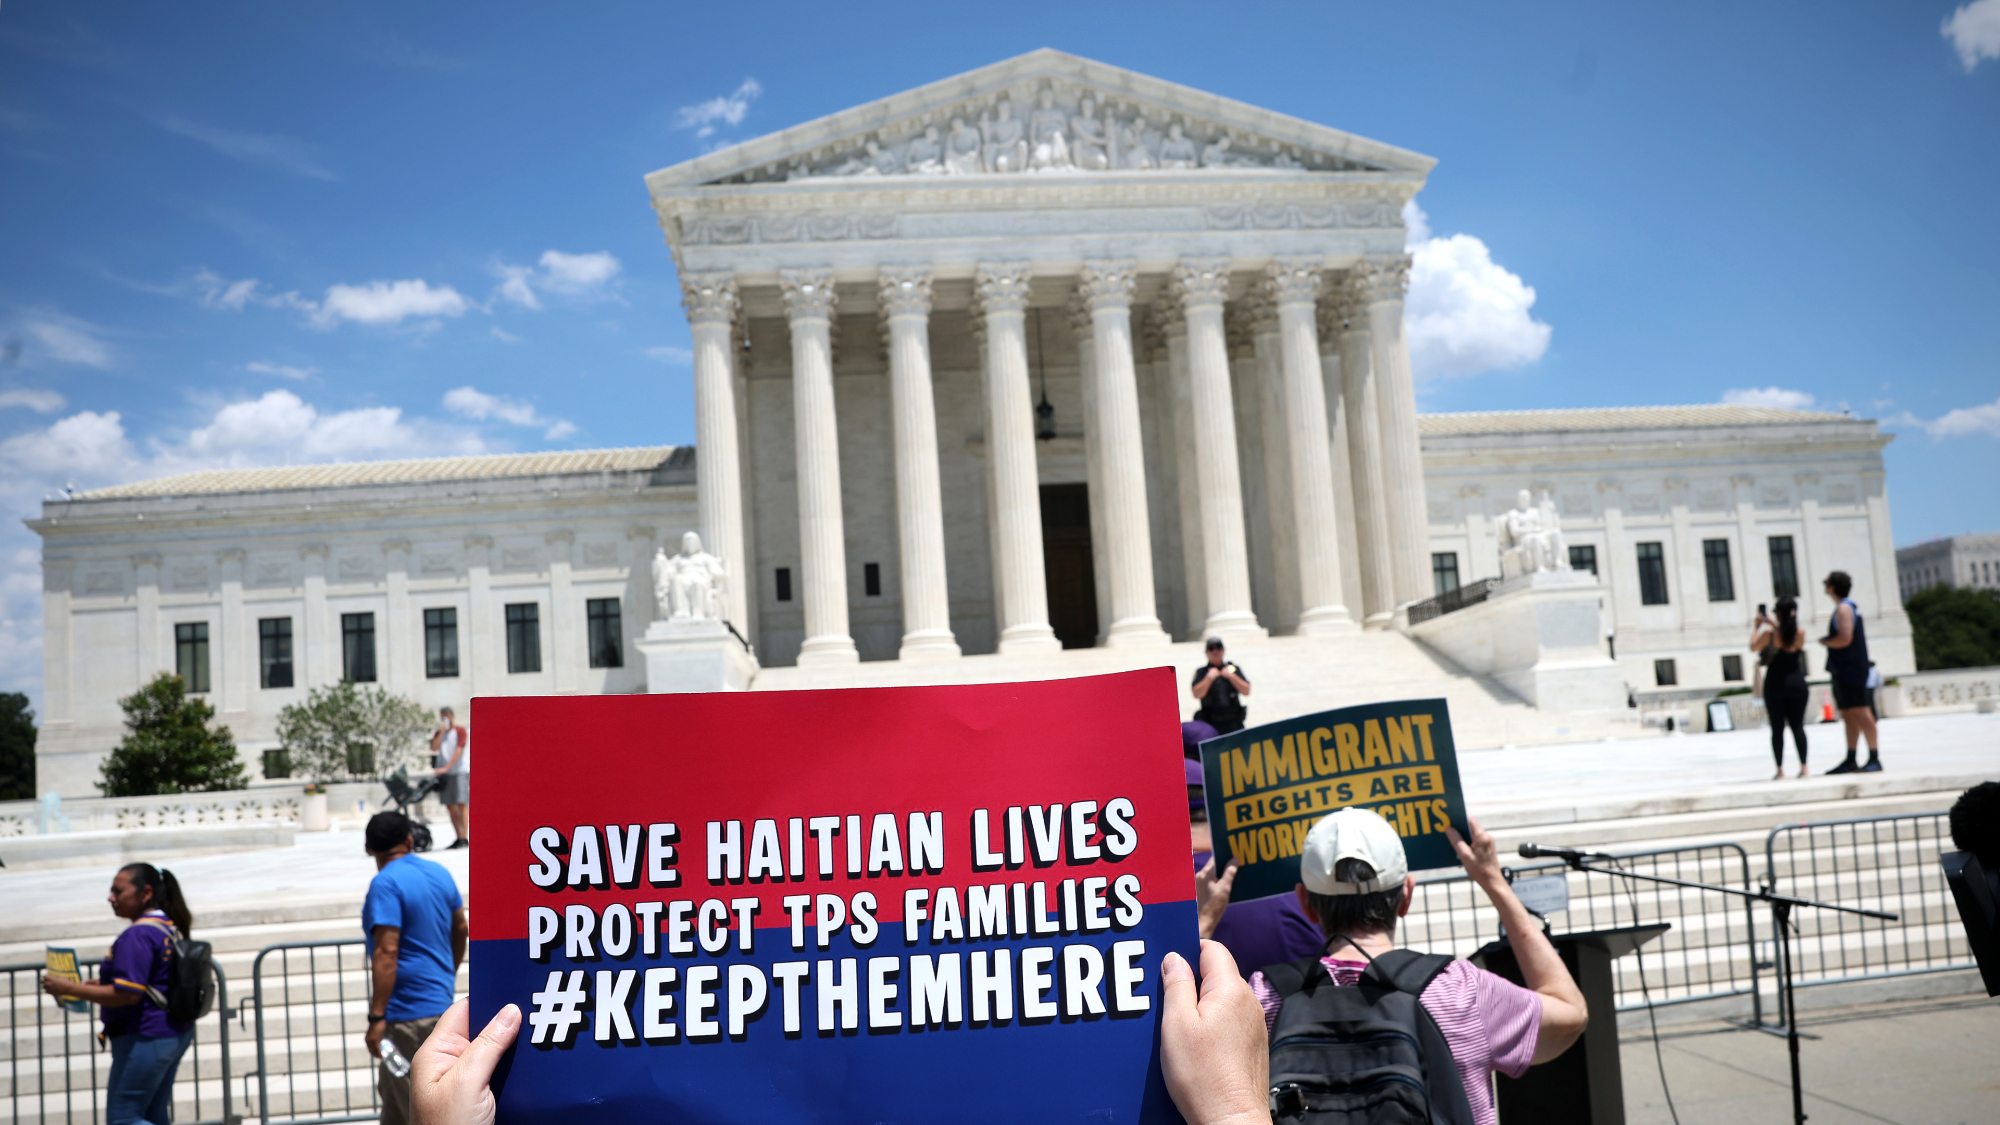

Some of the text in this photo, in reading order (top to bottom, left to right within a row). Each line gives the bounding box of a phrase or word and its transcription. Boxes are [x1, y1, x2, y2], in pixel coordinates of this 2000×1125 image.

[1219, 714, 1436, 798] IMMIGRANT
[1236, 772, 1433, 823] RIGHTS ARE
[528, 797, 1138, 892] SAVE HAITIAN LIVES
[1228, 798, 1452, 867] WORK GHTS
[528, 874, 1144, 962] PROTECT TPS FAMILIES
[529, 940, 1151, 1045] #KEEPTHEMHERE
